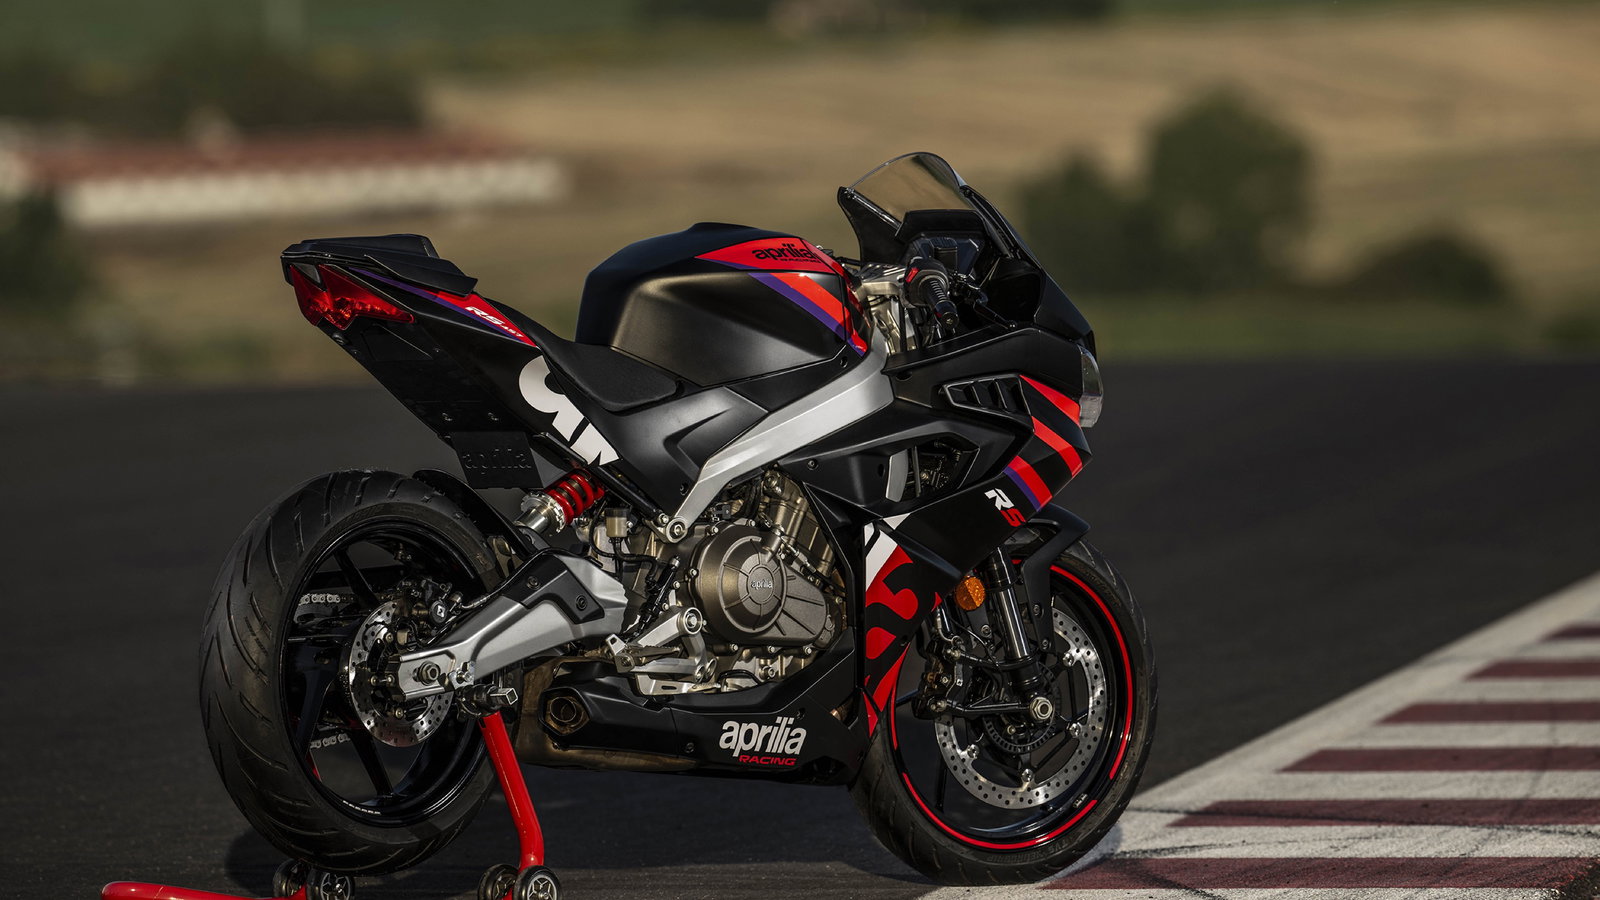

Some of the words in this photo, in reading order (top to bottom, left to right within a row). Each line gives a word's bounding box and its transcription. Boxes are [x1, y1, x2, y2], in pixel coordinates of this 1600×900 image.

[752, 243, 817, 260] aprilia
[465, 306, 505, 325] RS
[984, 487, 1027, 527] RS
[751, 578, 773, 590] aprilia
[719, 716, 807, 757] aprilia
[738, 754, 797, 766] RACING
